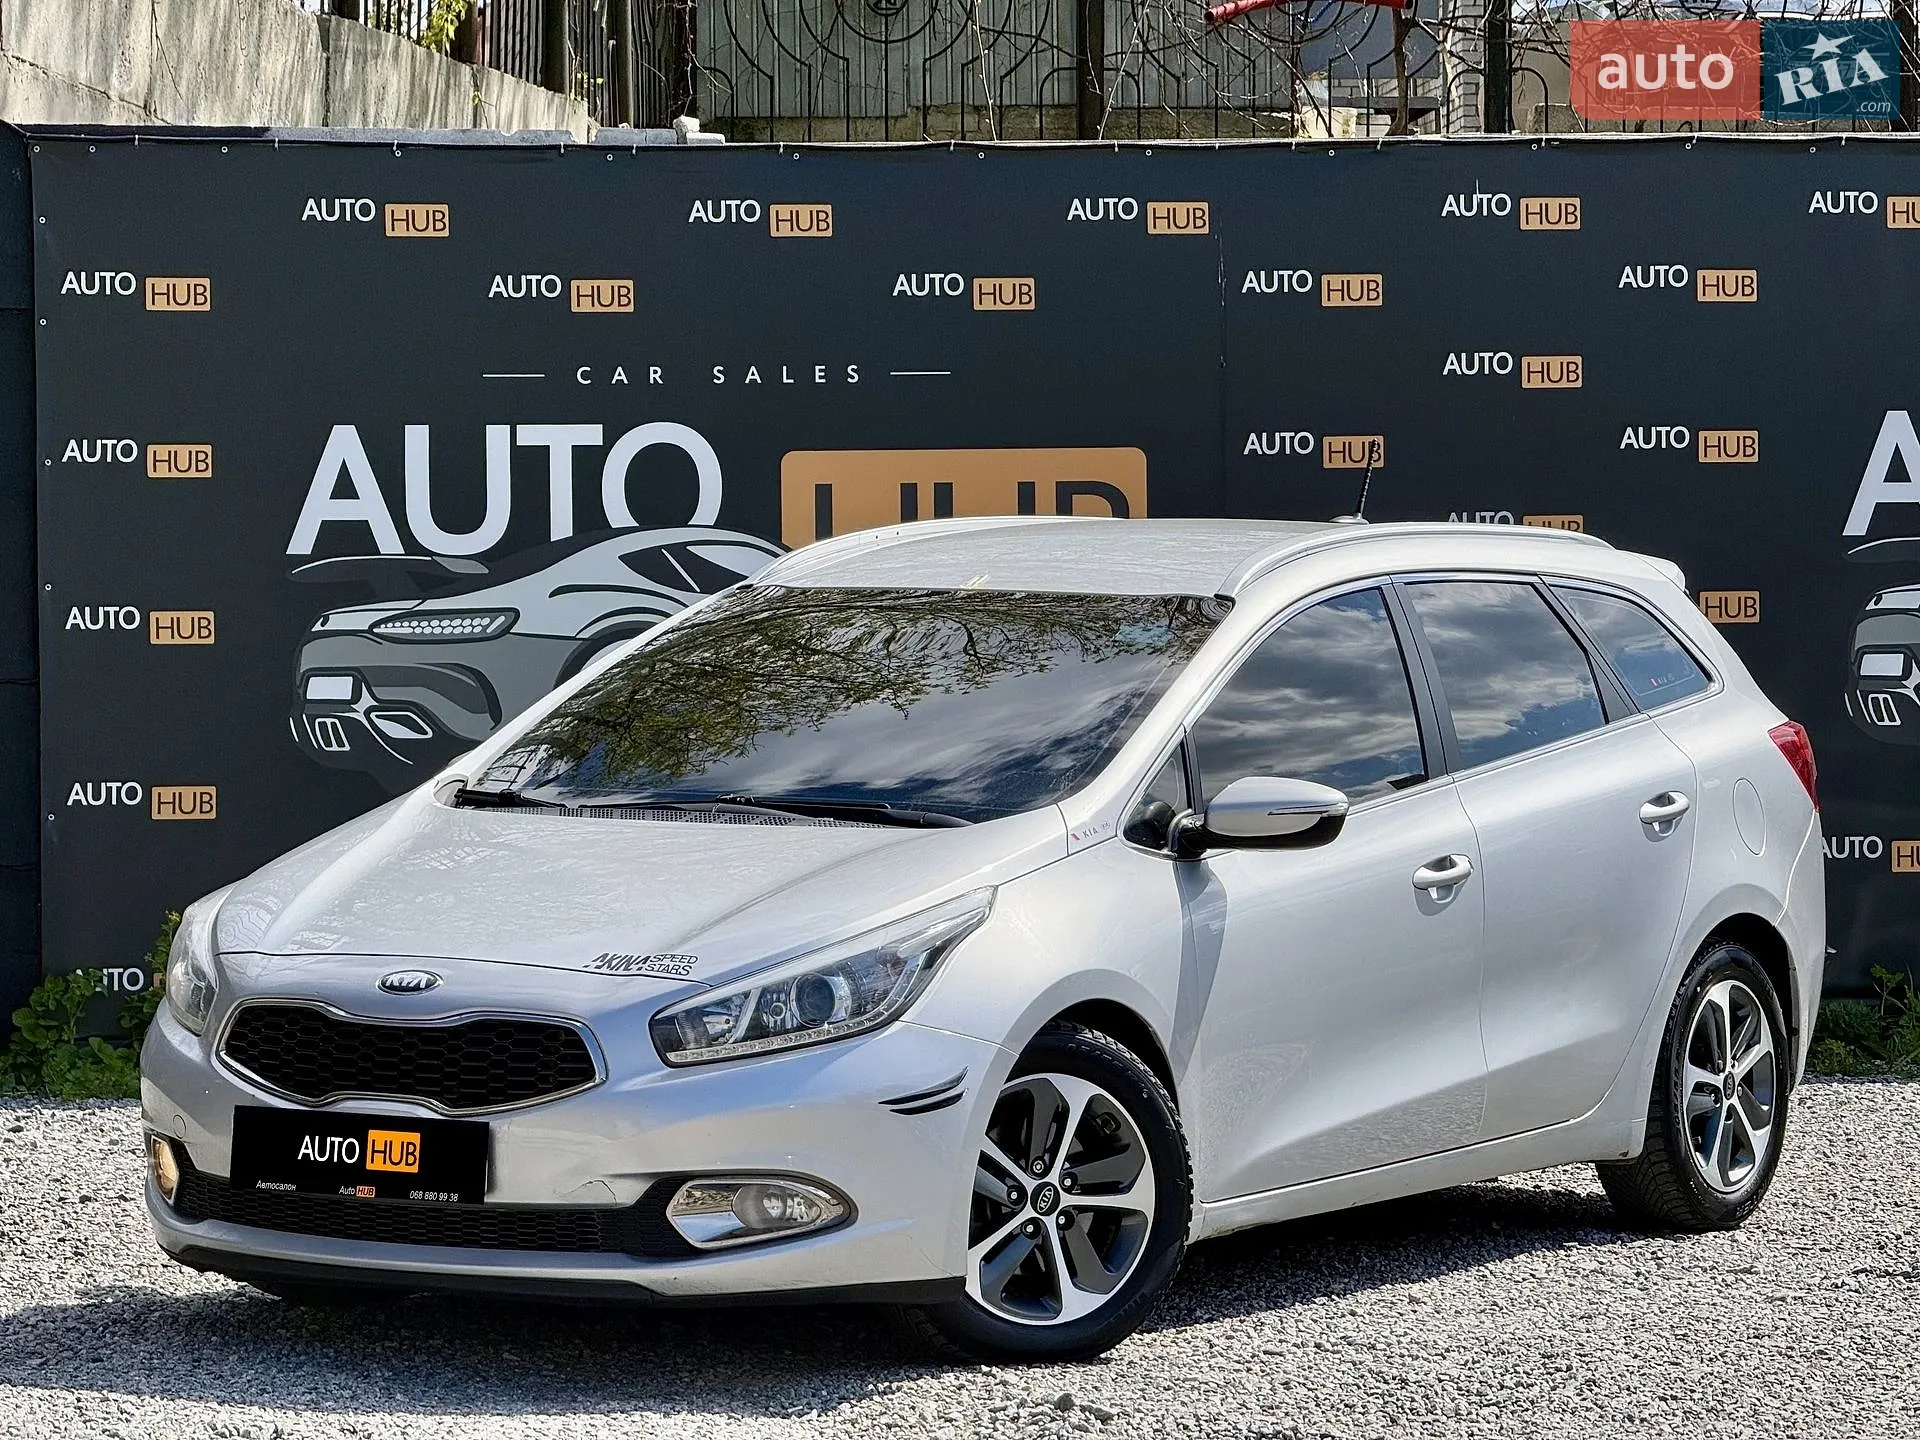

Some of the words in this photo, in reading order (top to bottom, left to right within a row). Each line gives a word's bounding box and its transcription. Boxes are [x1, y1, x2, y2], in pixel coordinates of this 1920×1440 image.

[302, 199, 375, 222] AUTO
[390, 210, 446, 232] HUB
[689, 200, 760, 222] AUTO
[775, 210, 829, 231] HUB
[1067, 198, 1138, 220] AUTO
[1153, 208, 1206, 228] HUB
[1442, 192, 1511, 216] AUTO
[1525, 204, 1577, 224] HUB
[1809, 191, 1878, 214] AUTO
[61, 272, 136, 295] AUTO
[151, 284, 207, 306] HUB
[489, 275, 561, 298] AUTO
[576, 286, 631, 307] HUB
[893, 273, 964, 296] AUTO
[978, 284, 1031, 305] HUB
[1242, 270, 1312, 293] AUTO
[1327, 280, 1379, 301] HUB
[1619, 265, 1688, 288] AUTO
[1702, 276, 1754, 296] HUB
[576, 366, 664, 385] CAR
[712, 364, 861, 384] SALES
[1443, 352, 1513, 375] AUTO
[1528, 362, 1579, 383] HUB
[62, 439, 137, 462] AUTO
[152, 451, 209, 472] HUB
[1244, 432, 1314, 455] AUTO
[1620, 426, 1689, 449] AUTO
[1704, 437, 1755, 457] HUB
[286, 421, 722, 556] AUTO
[65, 607, 140, 630] AUTO
[155, 617, 211, 639] HUB
[1705, 597, 1757, 619] HUB
[67, 782, 142, 805] AUTO
[157, 792, 213, 814] HUB
[582, 952, 650, 972] AKINA
[649, 953, 699, 965] SPEED
[644, 963, 694, 977] STARS
[297, 1134, 360, 1164] AUTO
[370, 1138, 418, 1168] HUB
[256, 1179, 297, 1191] Автосалон
[338, 1185, 356, 1196] Auto
[356, 1186, 375, 1197] HUB
[409, 1190, 423, 1200] 068
[437, 1192, 449, 1202] 99
[448, 1193, 459, 1203] 38
